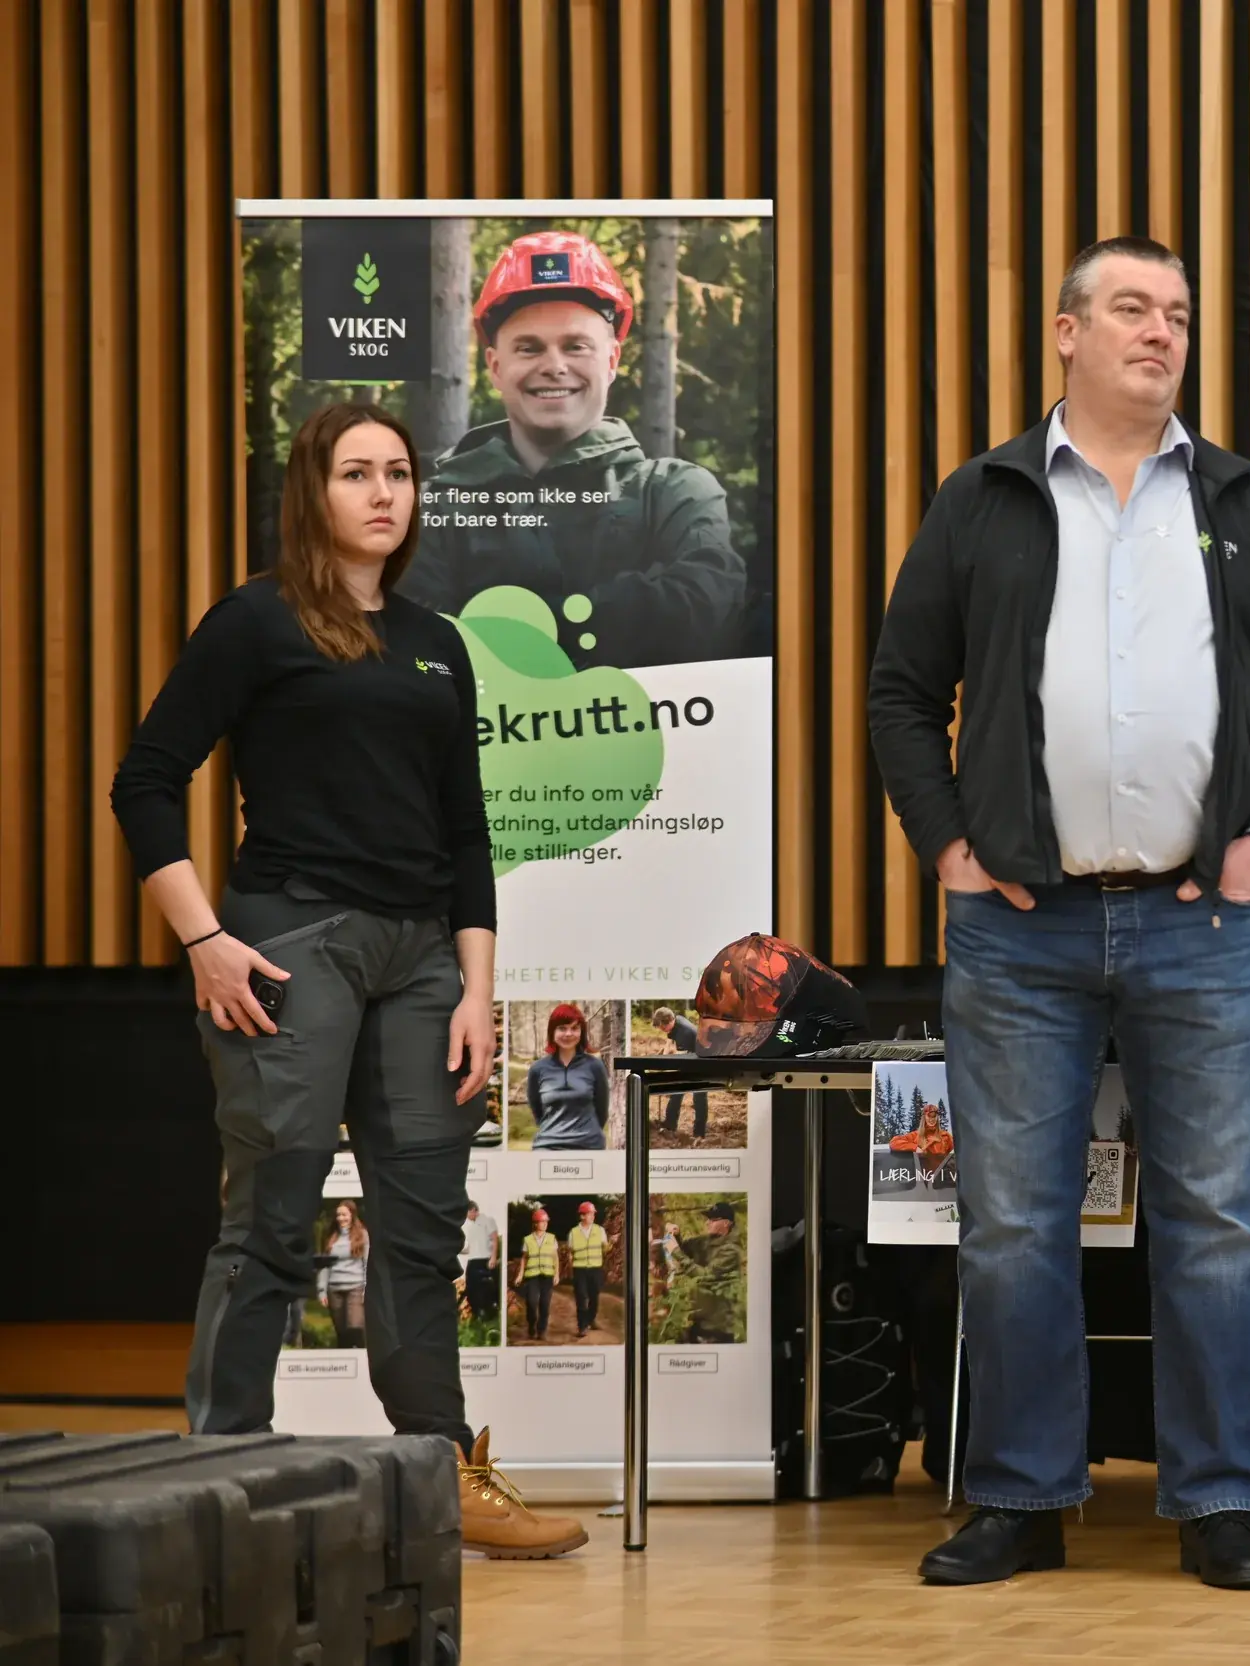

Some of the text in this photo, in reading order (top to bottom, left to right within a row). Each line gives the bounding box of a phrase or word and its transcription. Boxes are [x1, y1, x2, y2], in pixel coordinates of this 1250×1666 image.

[328, 317, 406, 338] VIKEN
[349, 343, 388, 356] SKOG
[446, 488, 490, 503] flere
[495, 491, 534, 503] som
[539, 488, 576, 503] ikke
[581, 491, 611, 503] ser
[422, 511, 548, 527] for bare trær.
[477, 695, 715, 747] ekrutt.no
[509, 785, 536, 802] du
[543, 784, 584, 801] info
[591, 787, 623, 801] om
[630, 784, 663, 801] vår
[566, 813, 724, 834] utdanningsløp
[524, 844, 622, 864] stillinger.
[588, 967, 592, 981] I
[604, 966, 669, 981] VIKEN
[553, 1165, 580, 1174] Biolog
[880, 1167, 935, 1183] LÆRLING
[536, 1361, 594, 1371] Veiplanlegger
[669, 1359, 706, 1369] Rådgiver
